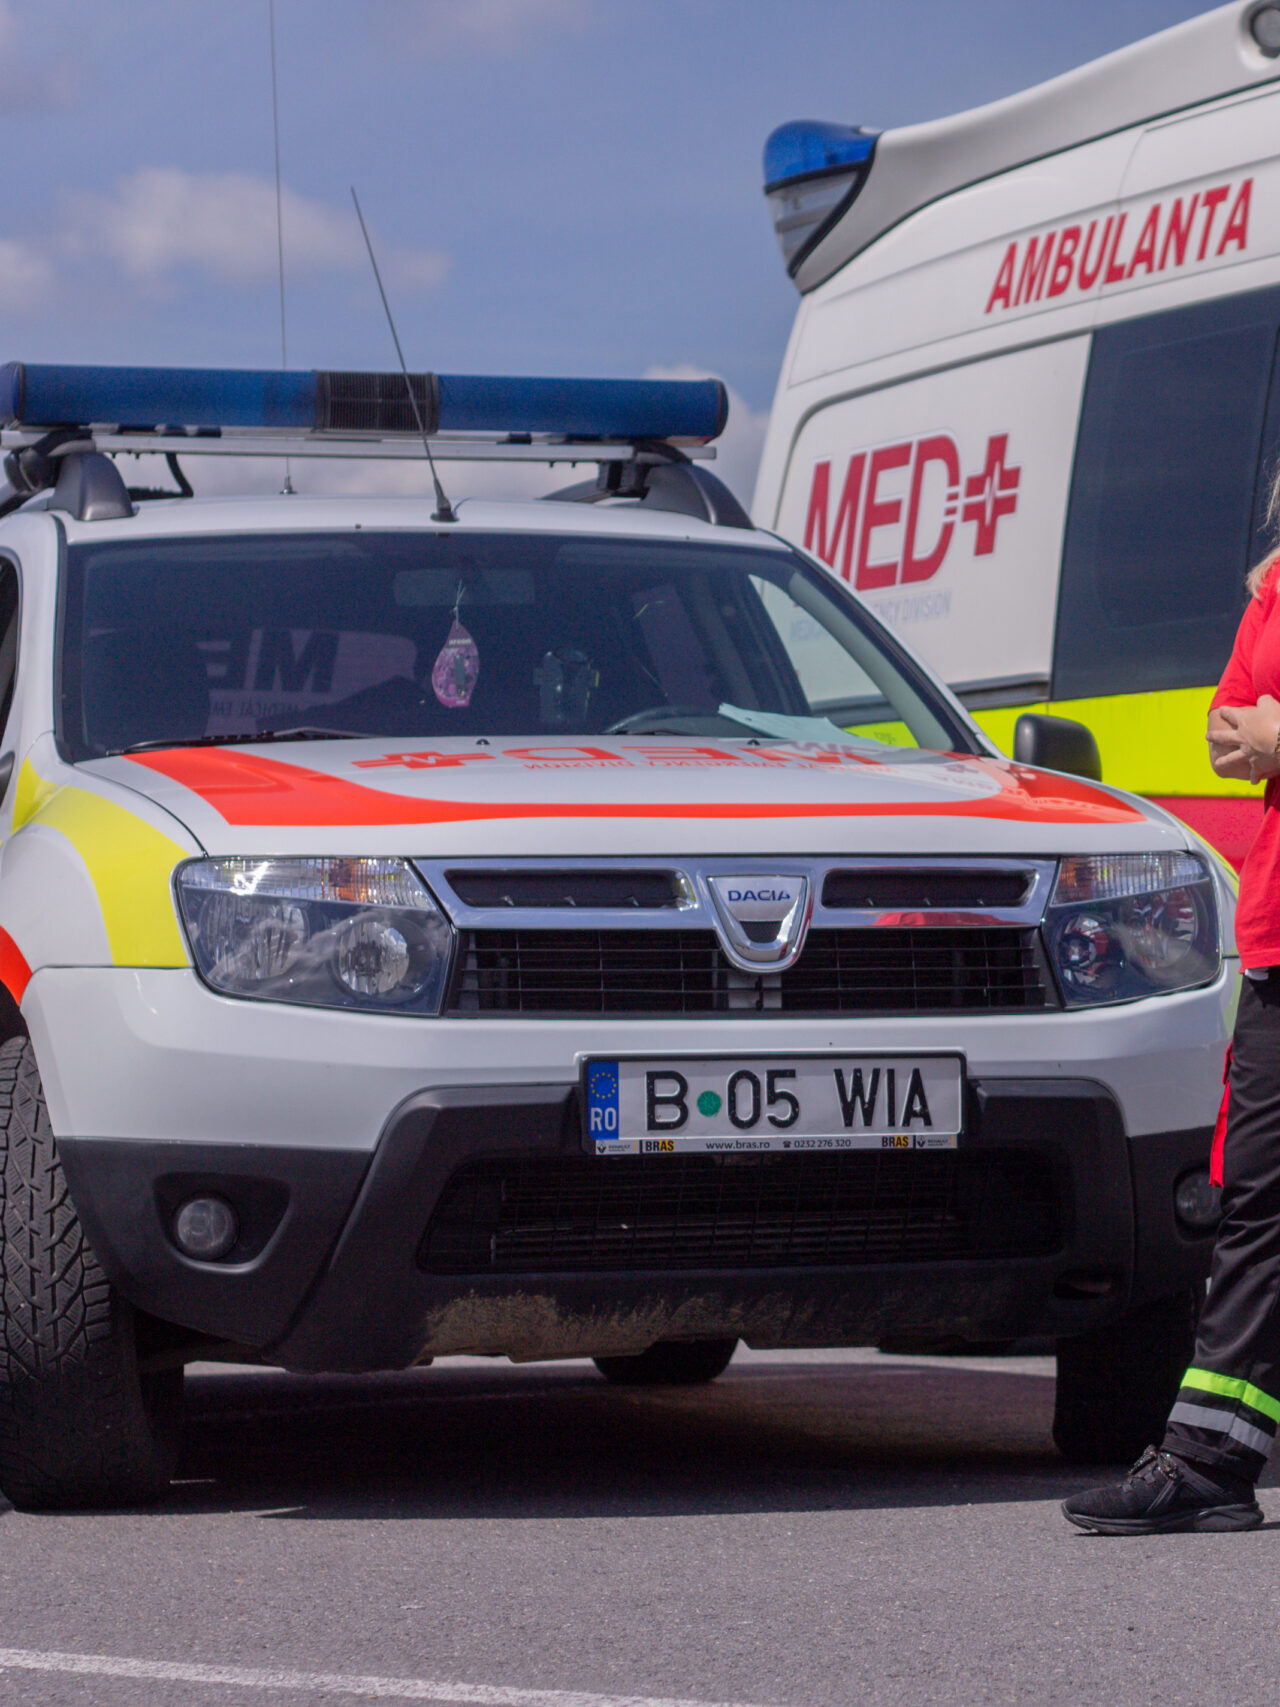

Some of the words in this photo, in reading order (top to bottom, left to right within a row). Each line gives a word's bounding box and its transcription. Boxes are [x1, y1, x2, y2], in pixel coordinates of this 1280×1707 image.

[984, 178, 1254, 314] AMBULANTA
[803, 434, 960, 592] MED
[728, 890, 791, 901] DACIA
[645, 1070, 690, 1131] B
[727, 1069, 800, 1130] 05
[833, 1067, 932, 1128] WIA
[591, 1107, 617, 1131] RO
[645, 1139, 675, 1152] BRAS
[706, 1139, 770, 1150] www.bras.ro
[794, 1139, 815, 1149] 0232
[817, 1139, 833, 1148] 276
[881, 1136, 909, 1148] BRAS
